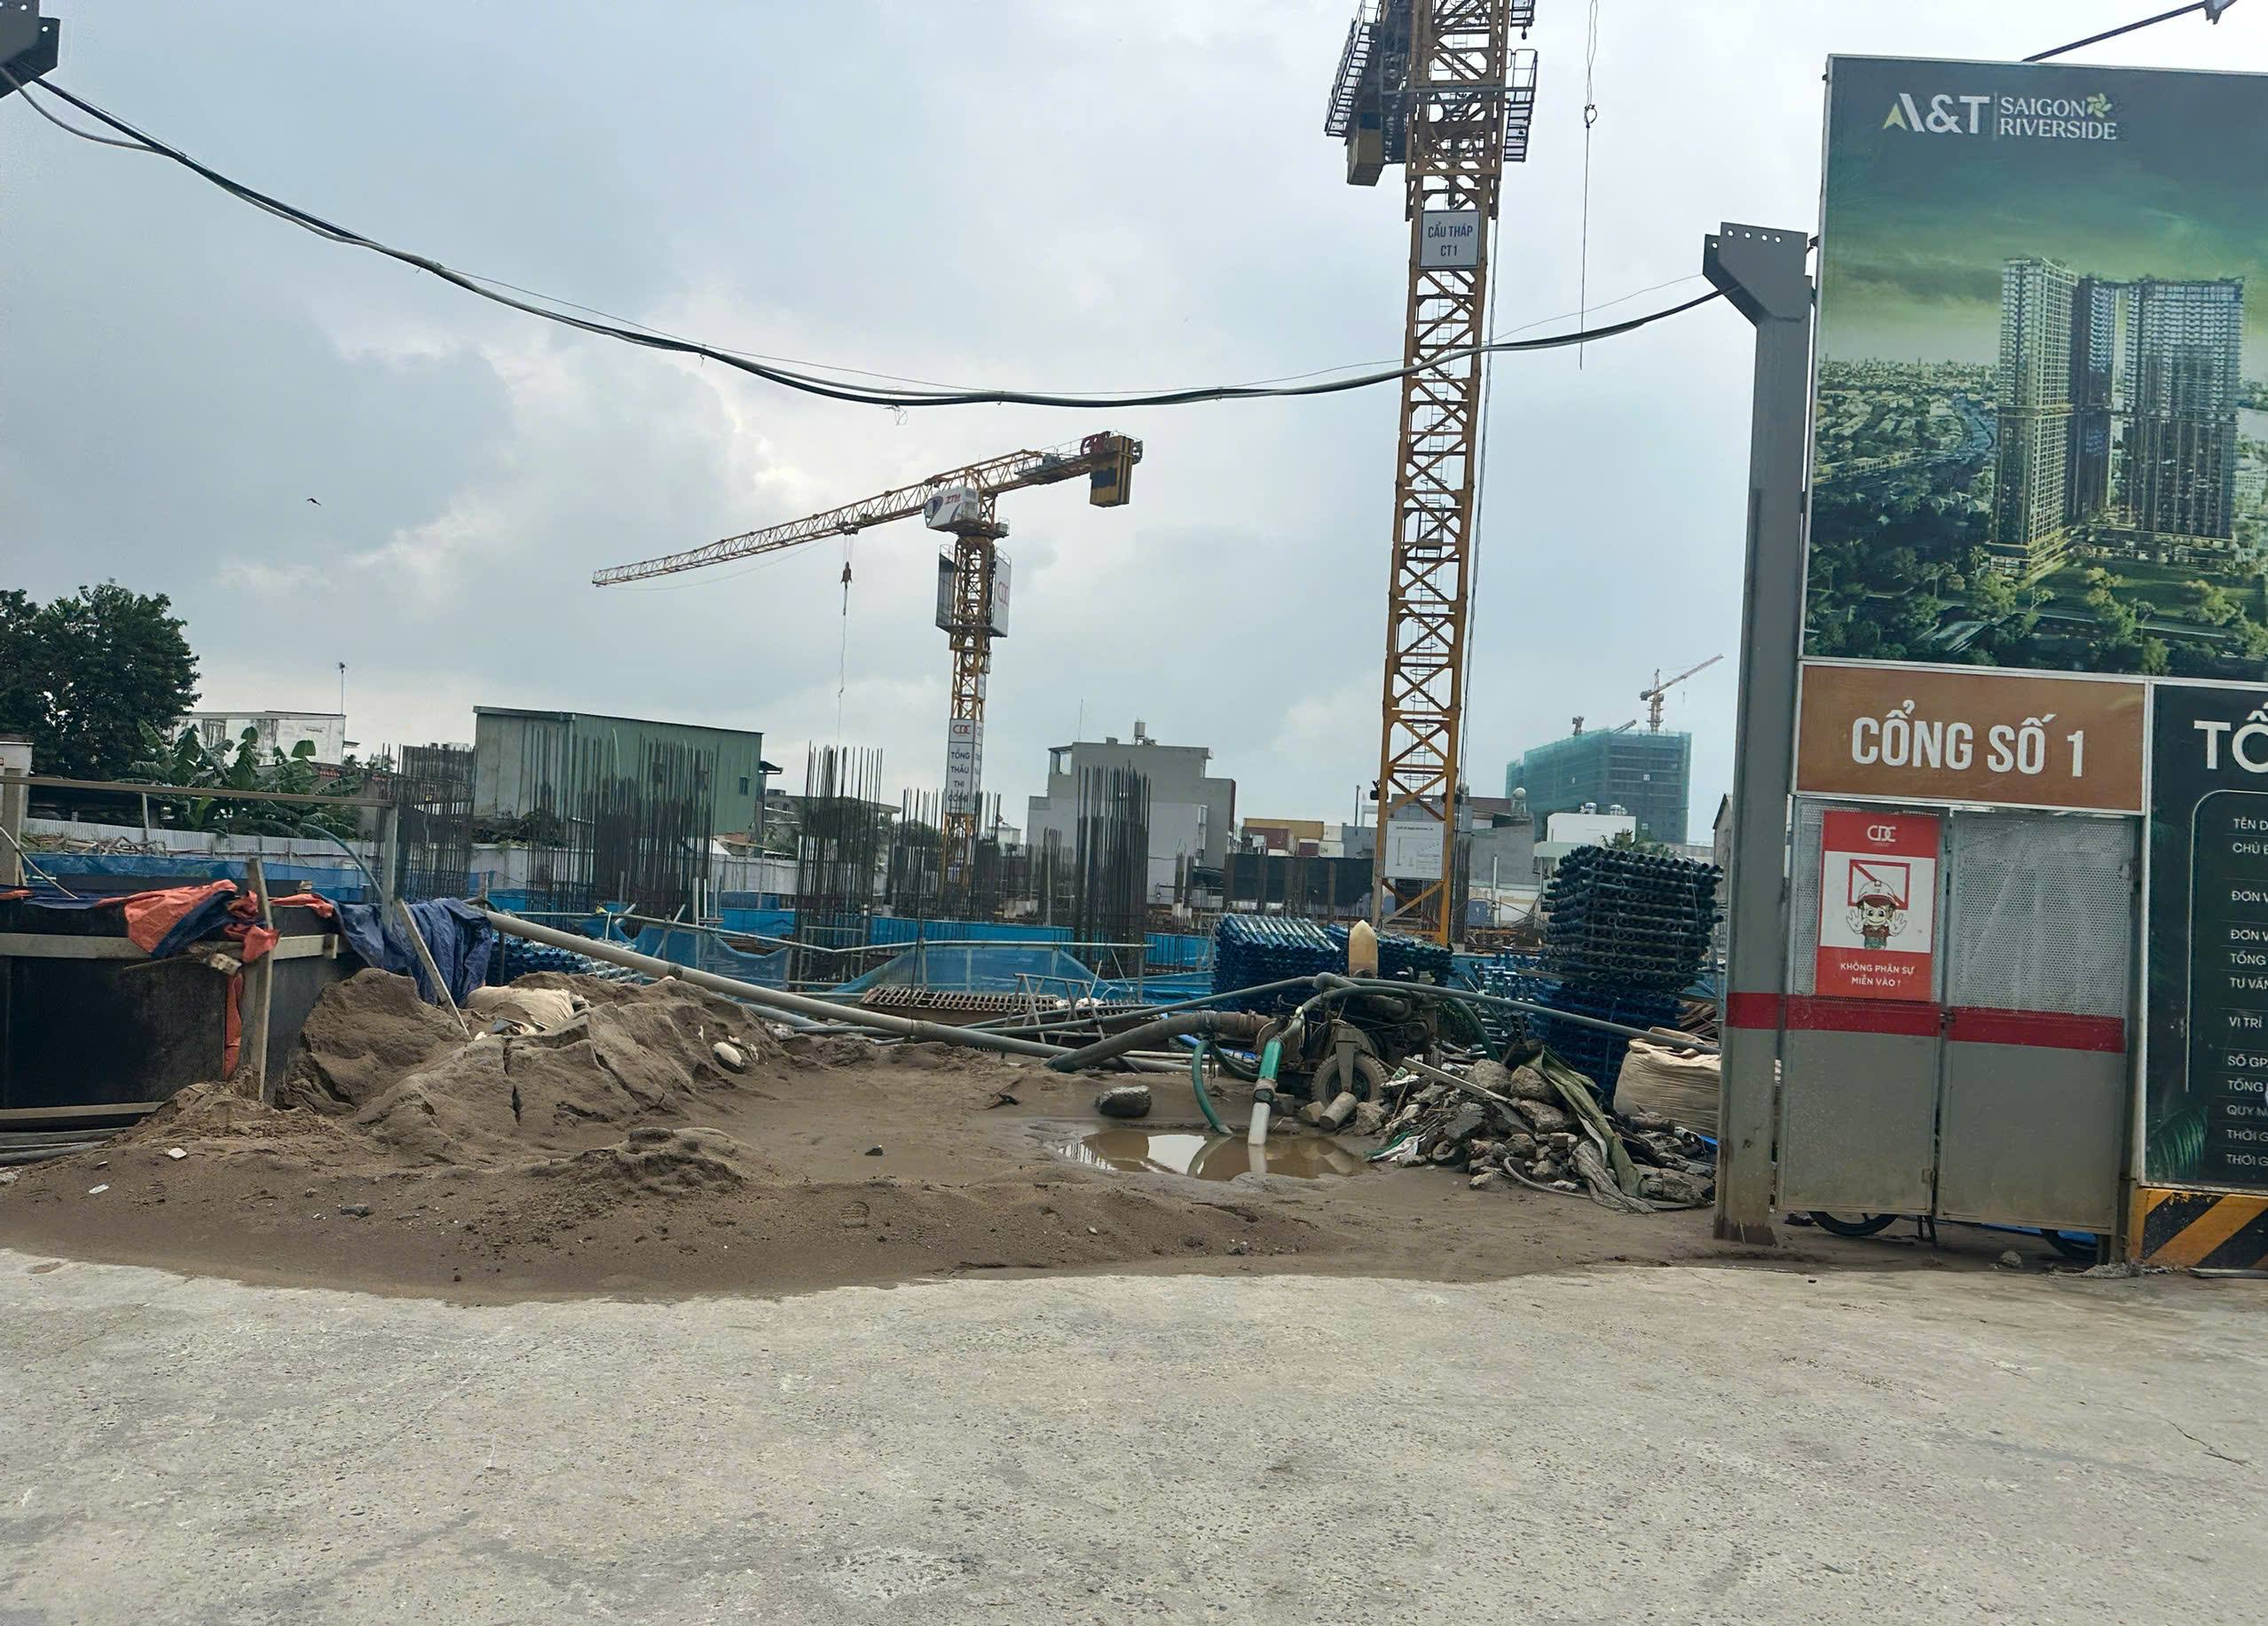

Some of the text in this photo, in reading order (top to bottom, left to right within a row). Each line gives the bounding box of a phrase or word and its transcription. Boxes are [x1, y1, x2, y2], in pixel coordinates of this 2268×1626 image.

[1882, 92, 1990, 134] A&T
[2000, 97, 2084, 118] SAIGON
[2000, 118, 2117, 140] RIVERSIDE
[1449, 224, 1473, 238] THÁP
[1851, 699, 2084, 777] CỔNG SỐ 1
[954, 780, 965, 789] THI
[2233, 816, 2256, 829] TÊN
[1867, 824, 1897, 843] CDC
[2233, 841, 2260, 854] CHỦ
[2232, 890, 2261, 902] ĐƠN
[2230, 929, 2259, 941] ĐƠN
[1840, 962, 1872, 971] KHÔNG
[1876, 977, 1895, 986] VÀO
[2243, 1015, 2263, 1029] TRÍ
[2228, 1054, 2268, 1068] SỐ GP
[2227, 1104, 2255, 1116] QUY
[2226, 1127, 2256, 1141] THỜI
[2226, 1152, 2256, 1166] THỜI
